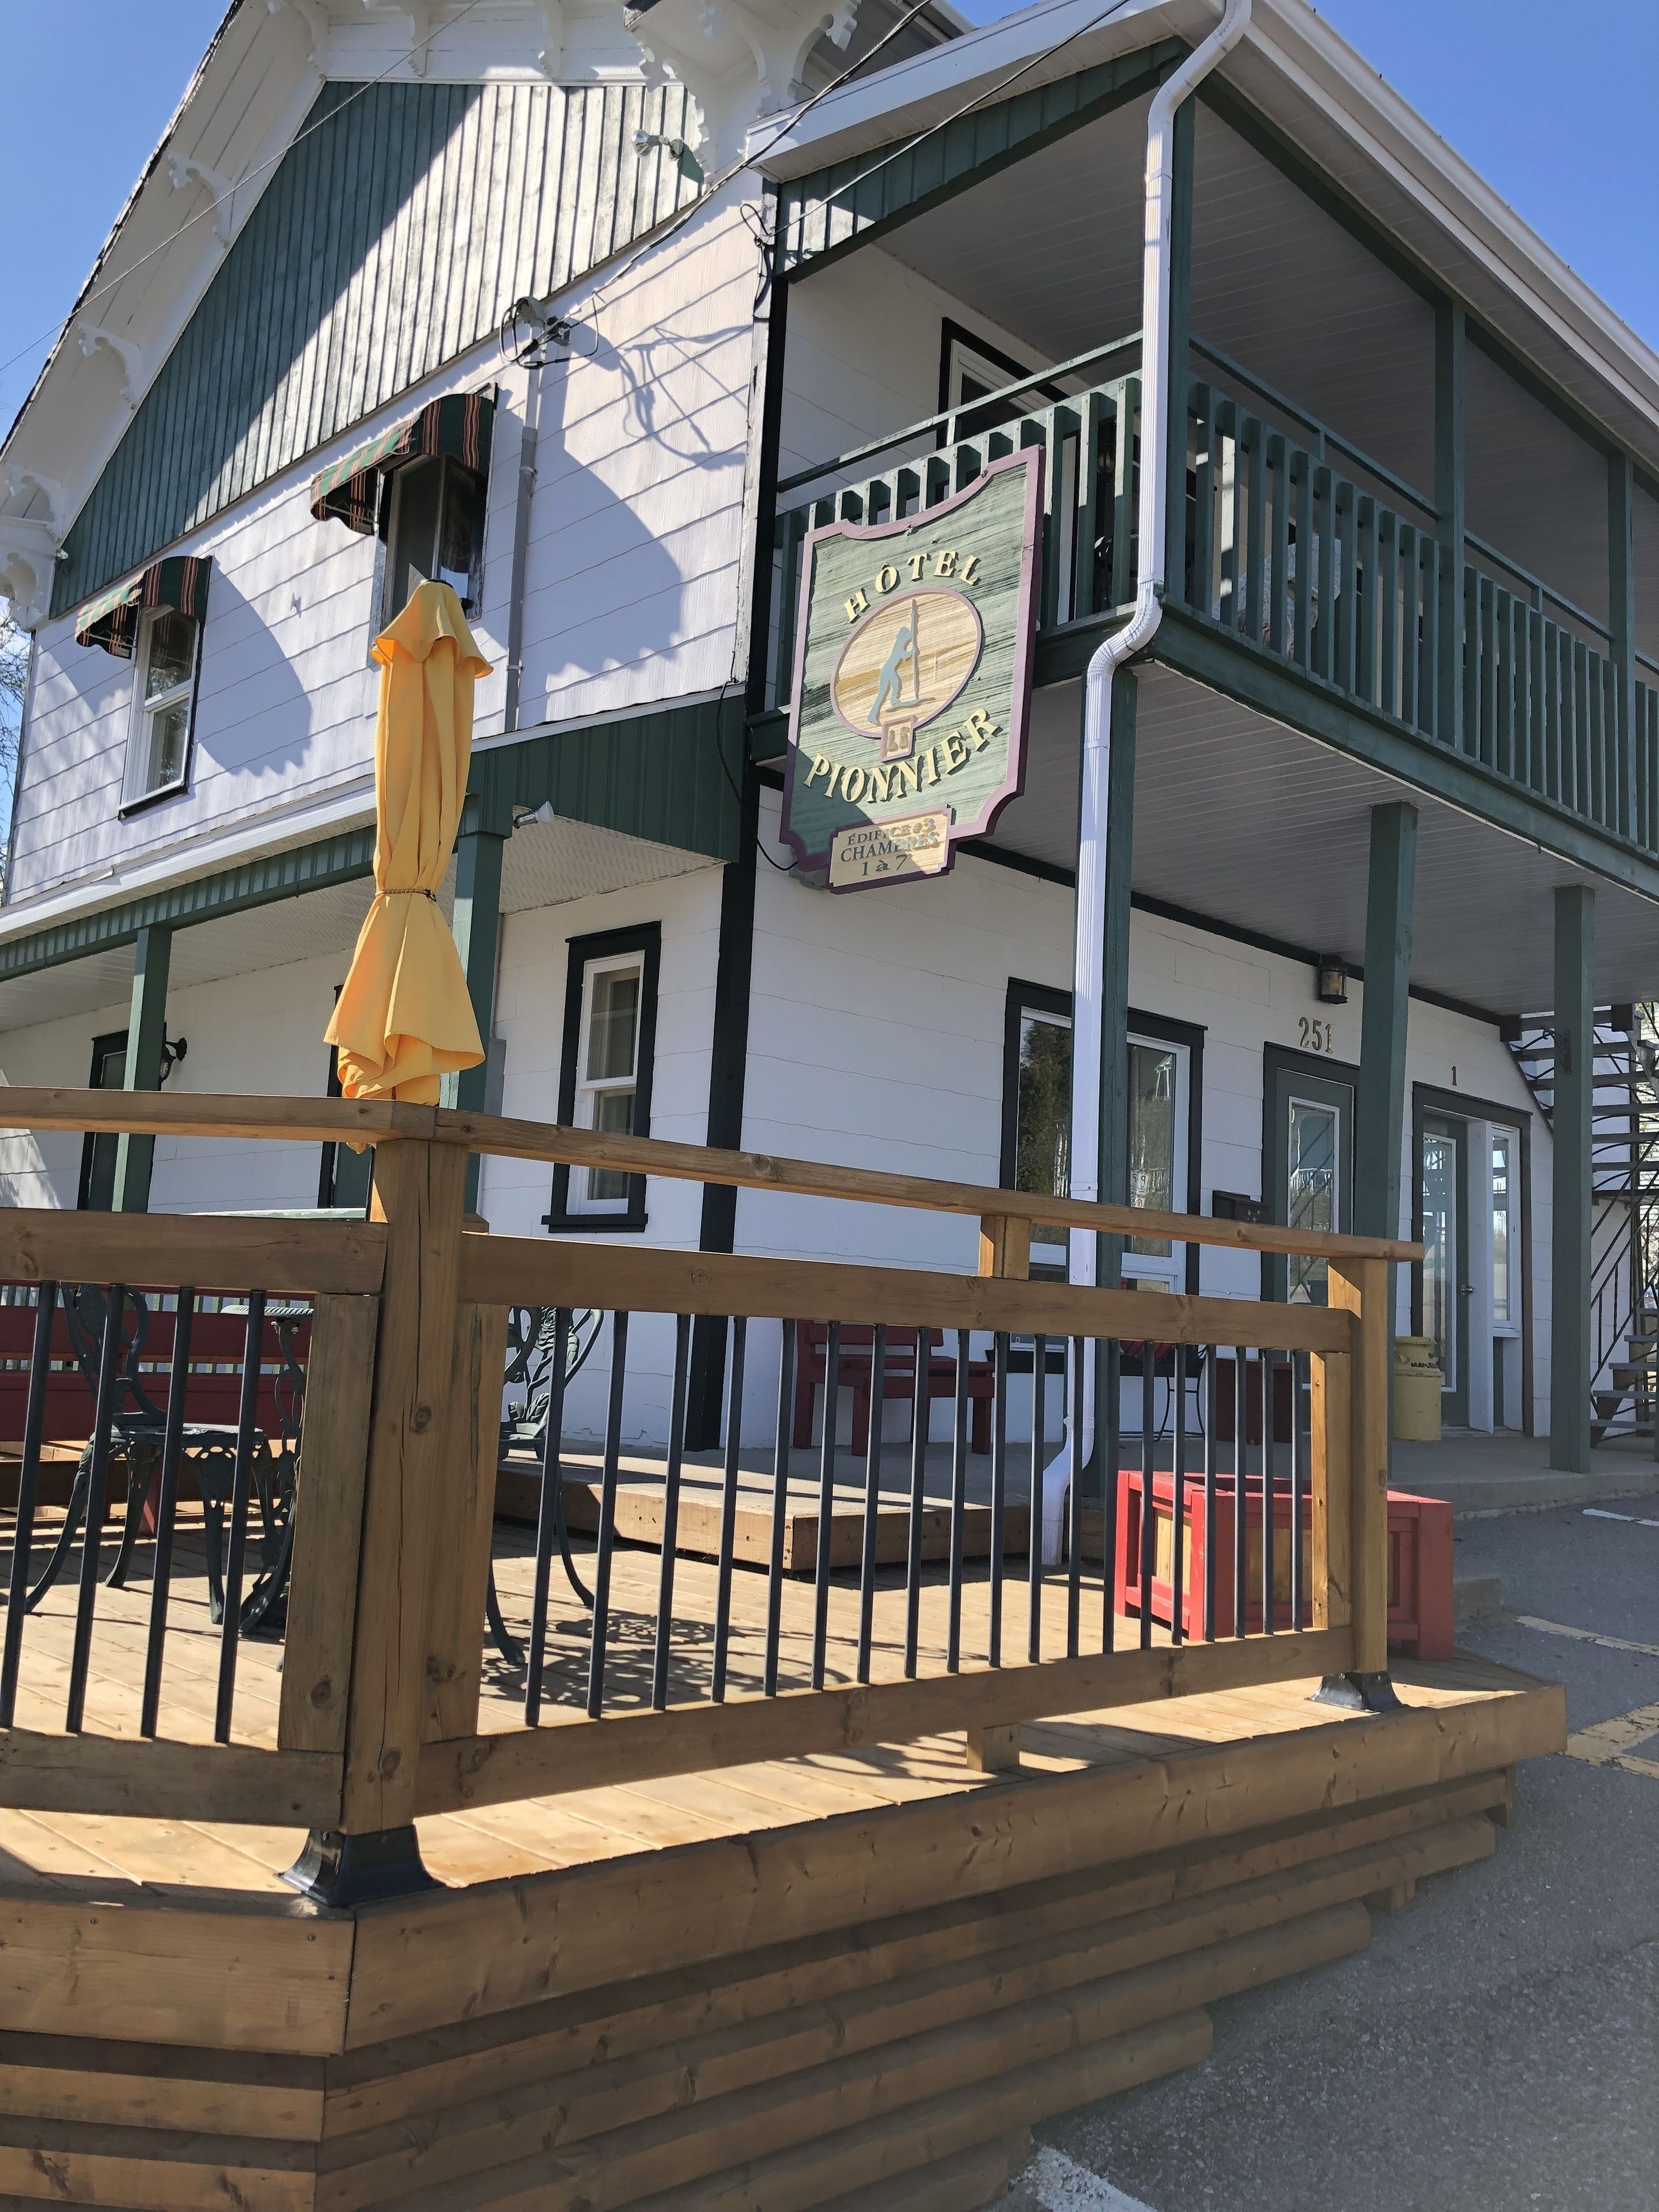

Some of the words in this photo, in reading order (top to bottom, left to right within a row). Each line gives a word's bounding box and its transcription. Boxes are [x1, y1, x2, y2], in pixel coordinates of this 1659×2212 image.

[843, 550, 980, 623] HÔTEL
[887, 726, 910, 752] LE
[803, 708, 1000, 803] PIONNIER
[840, 832, 940, 862] CHAMBRES
[847, 824, 911, 845] ÉDIFICE
[862, 861, 869, 876] 1
[876, 860, 889, 872] à
[896, 854, 909, 870] 7
[1298, 1017, 1334, 1054] 251
[1452, 1066, 1457, 1086] 1
